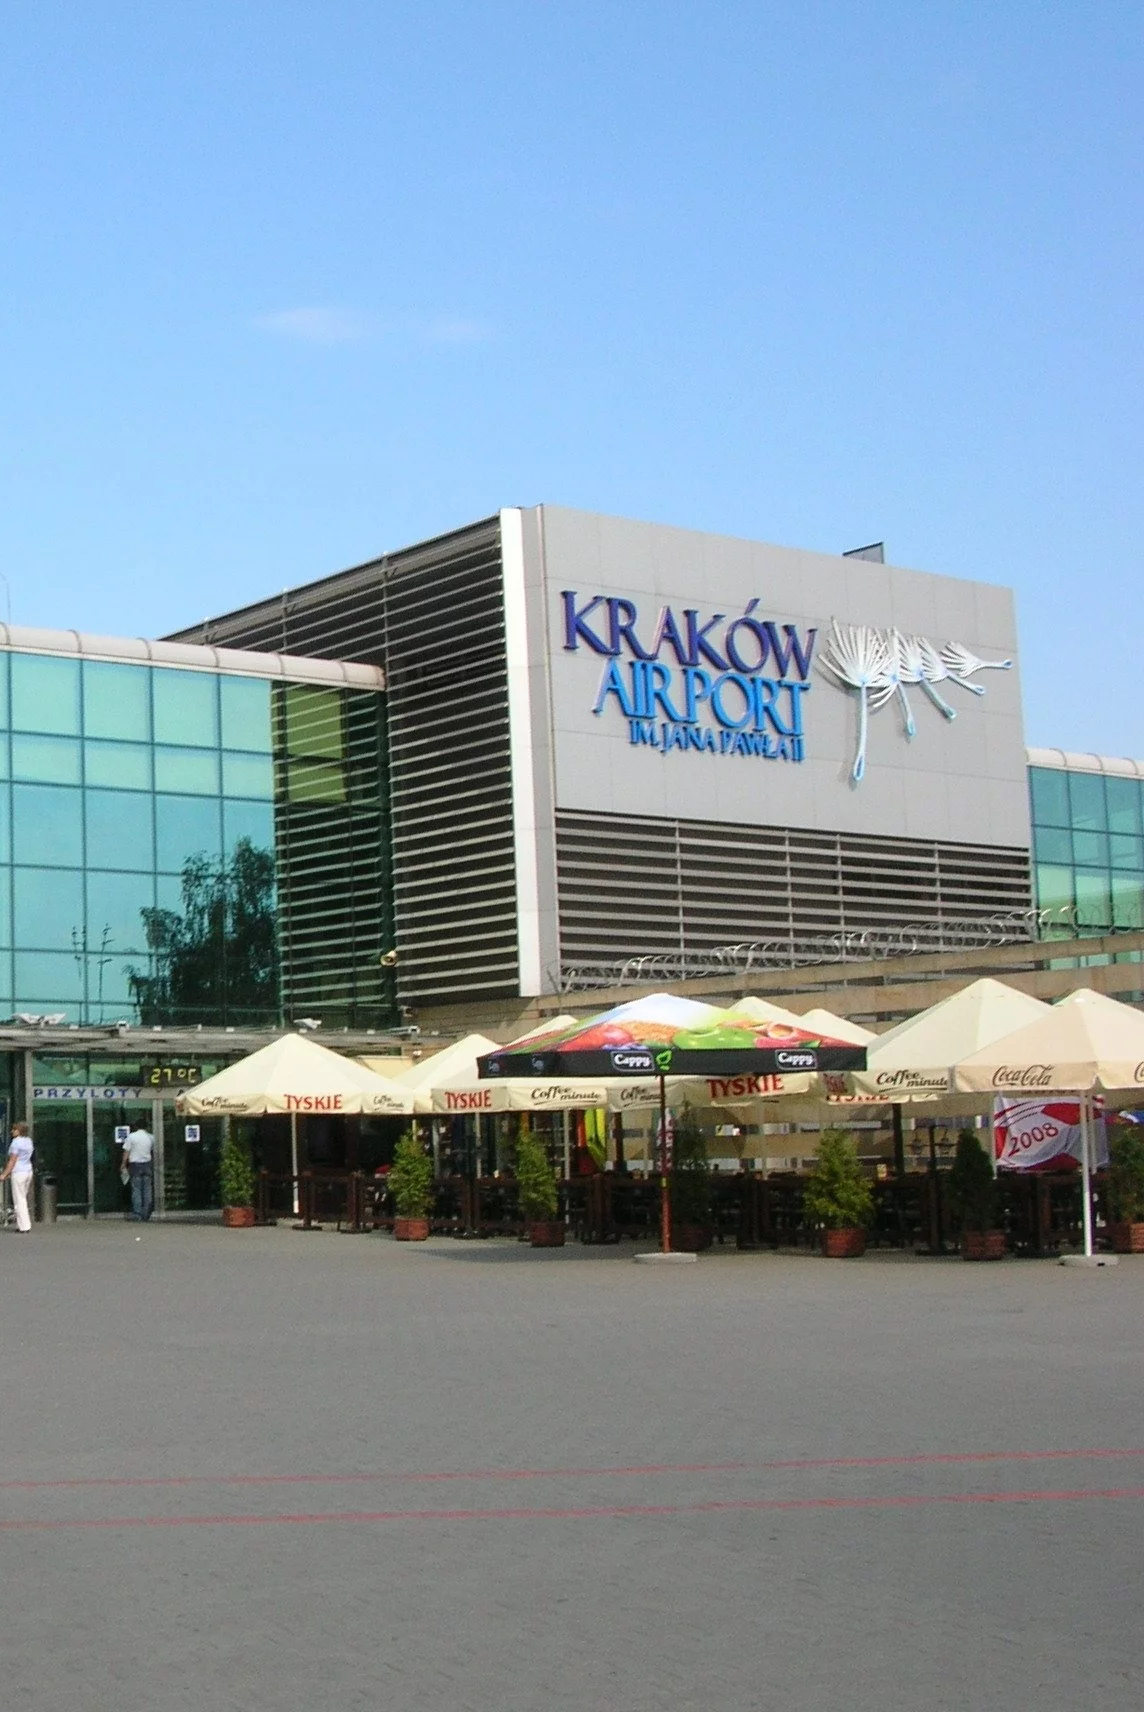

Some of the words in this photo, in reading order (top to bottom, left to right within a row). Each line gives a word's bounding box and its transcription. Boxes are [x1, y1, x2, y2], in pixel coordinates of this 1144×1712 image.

[560, 590, 818, 680] KRAKÓW
[591, 657, 812, 736] AIRPORT
[660, 723, 716, 754] JANA
[790, 737, 805, 762] II
[614, 1053, 652, 1068] Cappy
[778, 1052, 815, 1066] Cappy
[707, 1073, 784, 1098] TYSKIE
[876, 1069, 920, 1087] Coffee
[34, 1088, 142, 1098] PRZYLOTY
[284, 1094, 343, 1110] TYSKIE
[444, 1089, 492, 1109] TYSKIE
[531, 1085, 571, 1100] Coffee
[1008, 1122, 1059, 1158] 2008
